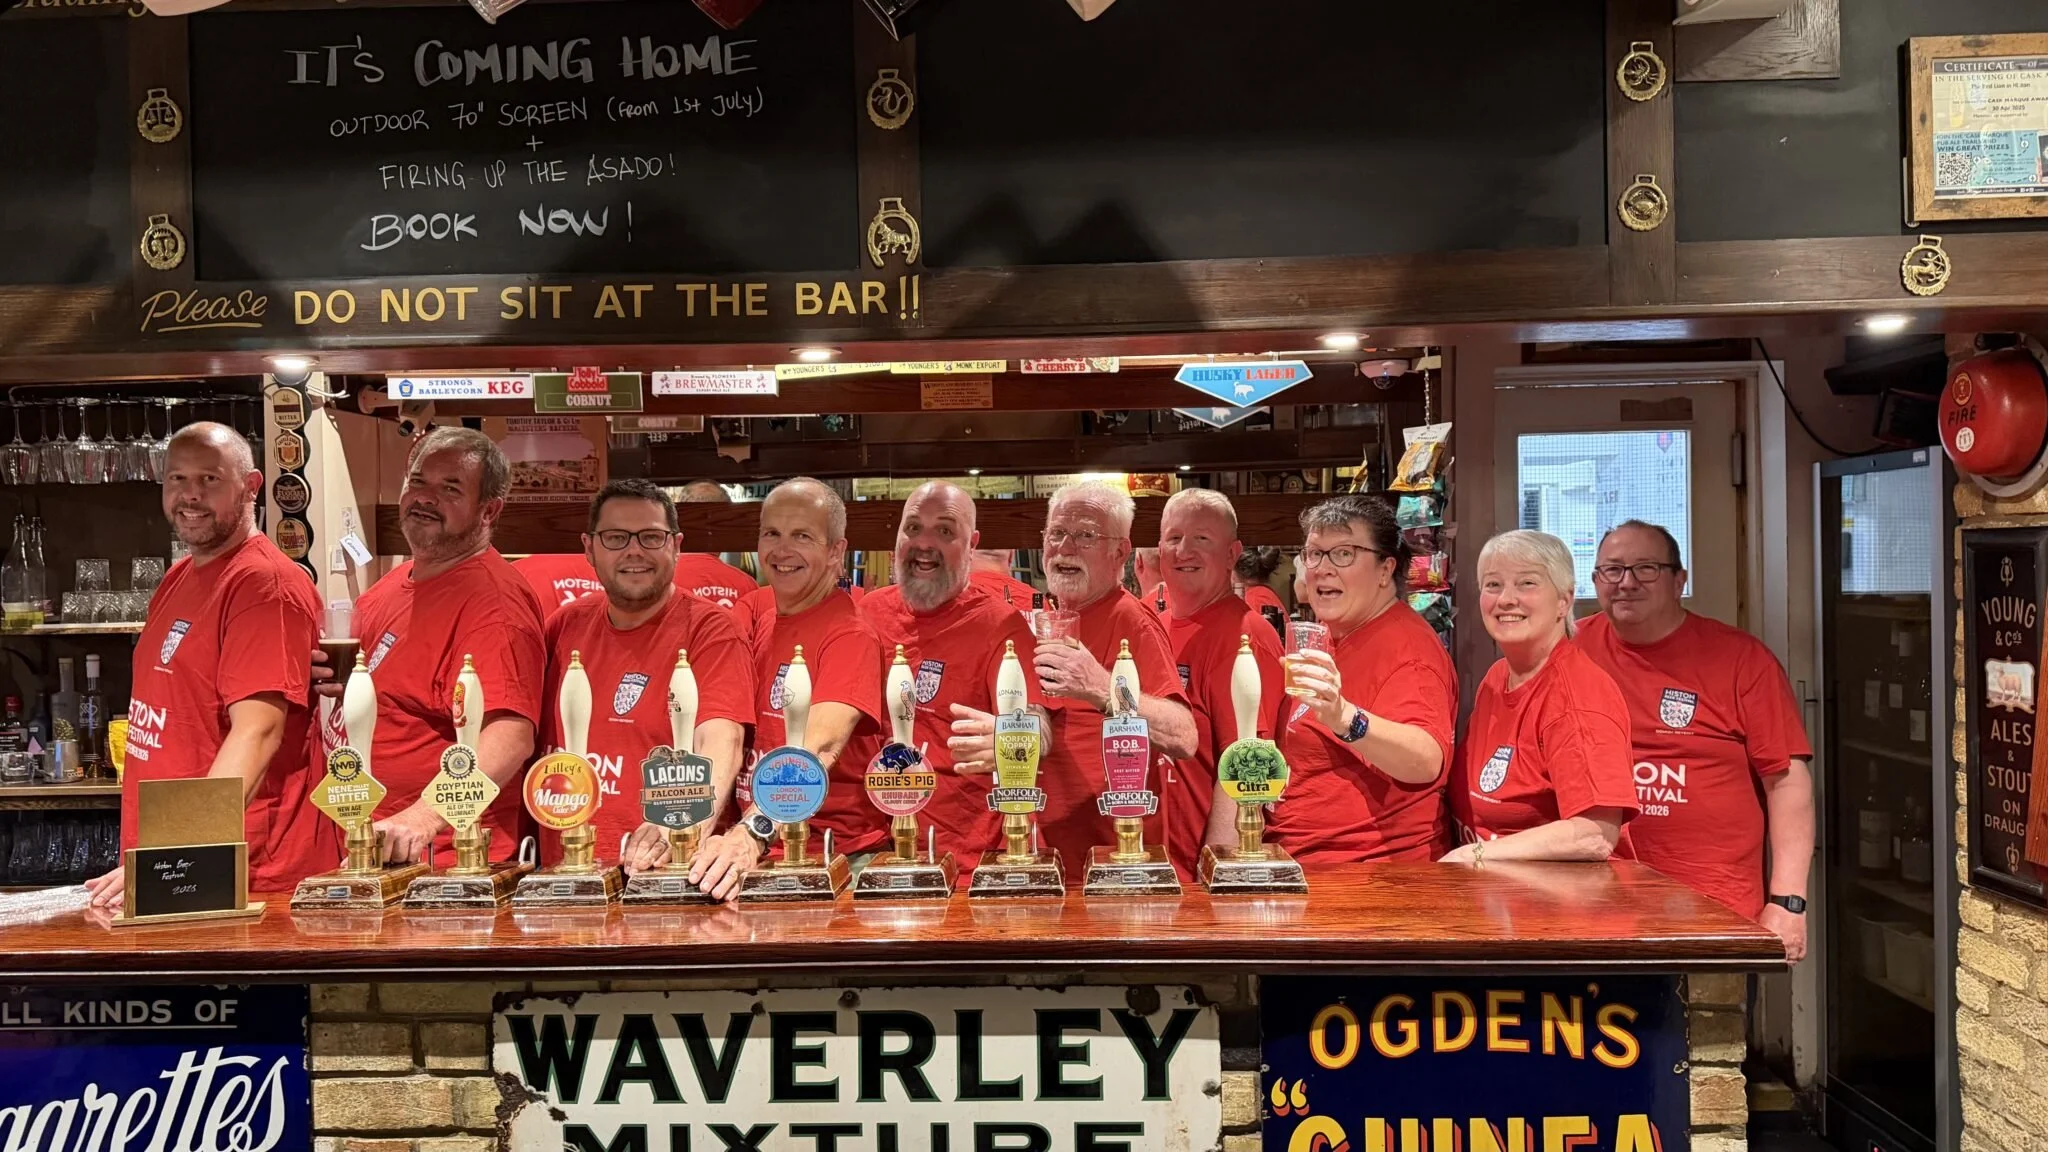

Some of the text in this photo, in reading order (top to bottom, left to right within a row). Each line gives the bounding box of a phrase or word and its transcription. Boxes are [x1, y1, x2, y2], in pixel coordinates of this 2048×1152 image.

[284, 35, 759, 87] IT'S COMING HOME
[1944, 61, 2015, 72] CERTIFICATE
[329, 108, 430, 137] OUTDOOR
[501, 96, 588, 126] SCREEN
[378, 160, 467, 191] FIRING
[485, 162, 507, 189] UP
[522, 159, 567, 184] THE
[360, 209, 479, 251] BOOK
[517, 203, 608, 239] NOW
[141, 289, 268, 333] Please
[293, 289, 357, 324] DO
[380, 286, 475, 324] NOT
[499, 283, 573, 320] SIT
[593, 284, 655, 319] AT
[675, 283, 769, 318] THE
[1036, 363, 1086, 372] CHERRY B
[1192, 367, 1296, 381] HUSKY LAGER
[487, 381, 524, 395] KEG
[569, 378, 606, 390] Cobbold
[675, 379, 753, 389] BREWMASTER
[418, 388, 483, 396] BARLEYCORN
[566, 394, 612, 406] COBNUT
[1948, 405, 1977, 426] FIRE
[1981, 595, 2037, 629] YOUNG
[1996, 630, 2004, 646] &
[1665, 689, 1696, 700] HISTON
[128, 697, 167, 731] STON
[1002, 721, 1034, 730] BARSHAM
[1109, 725, 1142, 734] BARSHAM
[1990, 719, 2032, 746] ALES
[1003, 742, 1033, 750] TOPPER
[1112, 740, 1139, 749] B.O.B.
[2007, 750, 2015, 762] &
[336, 761, 355, 770] NVB
[649, 765, 706, 786] LACONS
[868, 776, 934, 786] ROSIE'S PIG
[327, 785, 353, 794] NENE
[436, 781, 484, 791] EGYPTIAN
[1237, 781, 1270, 792] Citra
[328, 792, 370, 804] BITTER
[435, 791, 484, 803] CREAM
[651, 787, 704, 798] FALCON ALE
[769, 794, 809, 802] SPECIAL
[997, 788, 1038, 797] NORFOLK
[1107, 792, 1149, 800] NORFOLK
[1637, 786, 1688, 803] TIVAL
[534, 789, 589, 811] Mango
[1645, 805, 1670, 817] 2026
[2002, 799, 2021, 816] ON
[1984, 813, 2025, 837] DRAUG
[2, 1000, 238, 1025] LL KINDS OF
[1308, 982, 1640, 1069] OGDEN'S
[507, 1008, 1201, 1104] WAVERLEY
[0, 1046, 290, 1152] garettes
